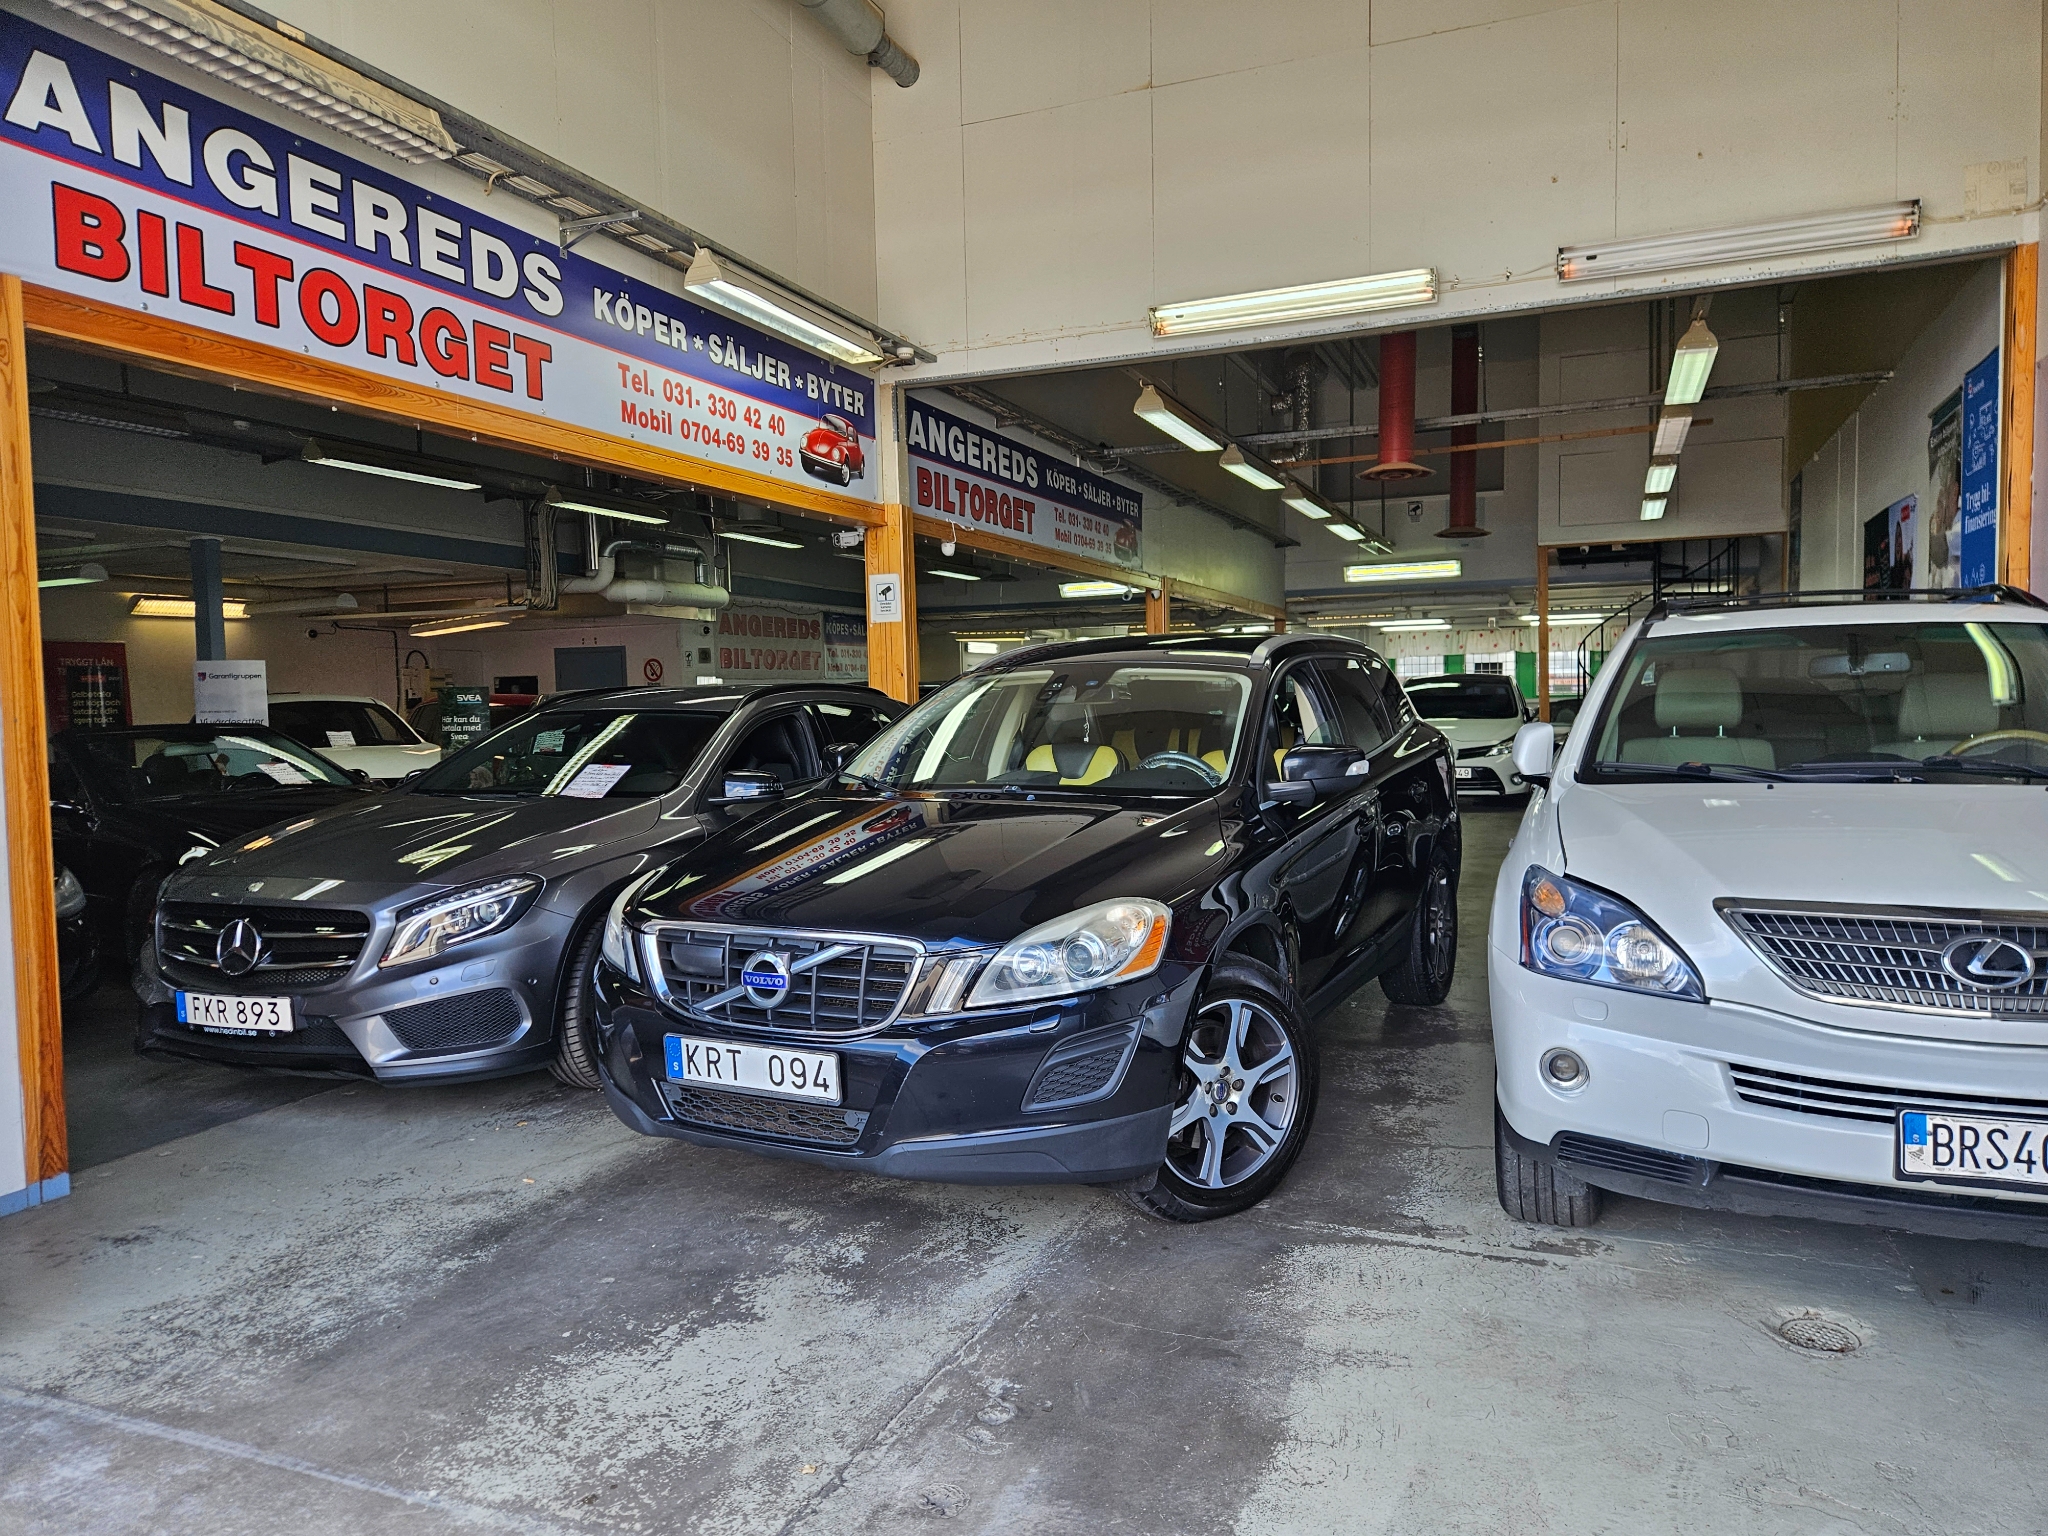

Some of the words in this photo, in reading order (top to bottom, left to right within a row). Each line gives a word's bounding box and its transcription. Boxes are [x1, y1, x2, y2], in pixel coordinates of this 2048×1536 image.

[4, 49, 562, 317] ANGEREDS
[52, 181, 552, 401] BILTORGET
[593, 287, 688, 353] KÖPER
[708, 334, 791, 390] SÄLJER
[807, 372, 865, 417] BYTER
[617, 362, 655, 397] Tel.
[663, 378, 700, 409] 031-
[708, 393, 737, 422] 330
[743, 406, 762, 430] 42
[768, 413, 785, 437] 40
[621, 400, 673, 435] Mobil
[680, 418, 745, 455] 0704-69
[752, 439, 770, 462] 39
[776, 446, 793, 468] 35
[908, 409, 1039, 489] ANGEREDS
[916, 465, 1036, 534] BILTORGET
[1046, 468, 1077, 496] KÖPER
[1083, 482, 1112, 508] SÄLJER
[1116, 495, 1139, 518] BYTER
[1054, 506, 1067, 524] Tel.
[1083, 516, 1093, 532] 330
[1054, 527, 1072, 544] Mobil
[718, 612, 821, 640] ANGEREDS
[60, 658, 94, 666] TRYGGT
[719, 647, 822, 671] BILTORGET
[208, 673, 262, 681] Garantigruppen
[456, 694, 482, 702] SVEA
[441, 724, 461, 732] betala
[463, 724, 482, 732] med
[453, 715, 468, 723] kan
[469, 715, 481, 723] du
[1455, 769, 1470, 777] 49
[744, 975, 784, 986] VOLVO
[192, 997, 229, 1024] FKR
[236, 1001, 280, 1026] 893
[673, 1062, 679, 1071] S
[685, 1043, 742, 1081] KRT
[768, 1054, 830, 1093] 094
